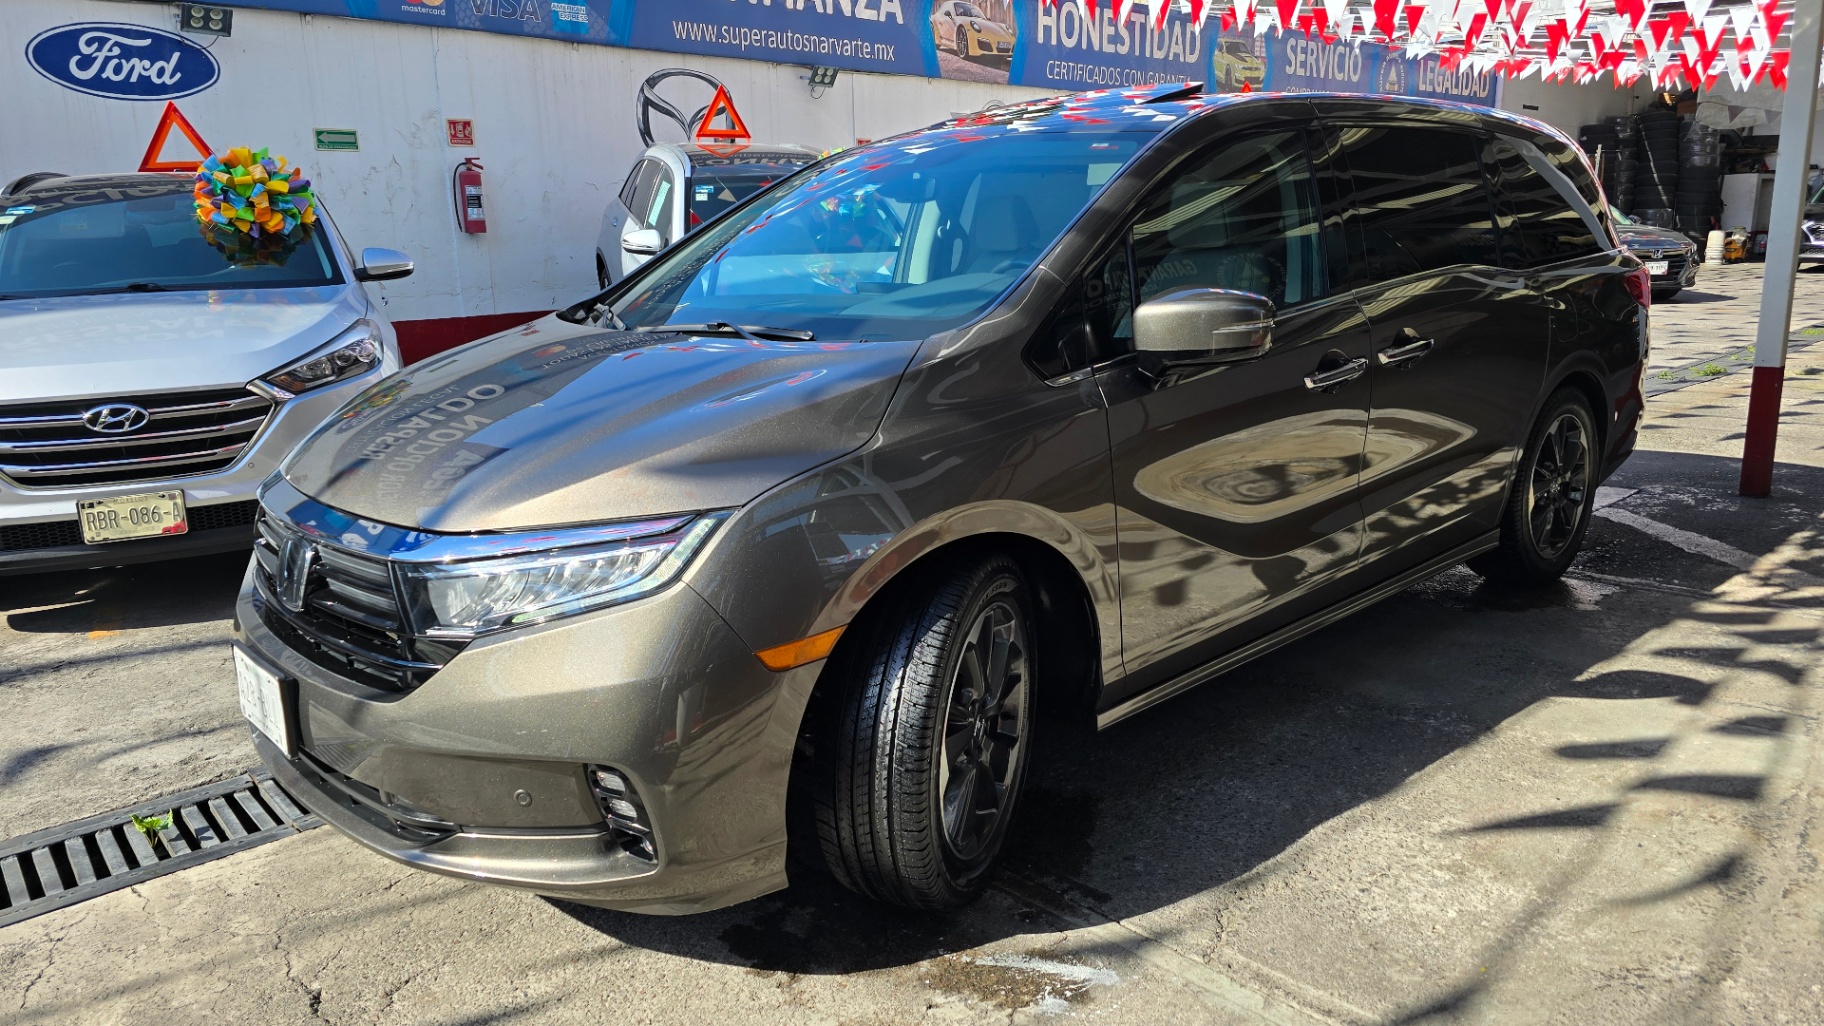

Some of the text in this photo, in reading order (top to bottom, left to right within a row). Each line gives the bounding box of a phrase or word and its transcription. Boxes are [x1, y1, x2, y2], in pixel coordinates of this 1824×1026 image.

[401, 5, 446, 16] mastercard
[470, 0, 541, 22] VISA
[551, 2, 586, 14] AMERICAN
[558, 11, 588, 23] EXPRESS
[672, 20, 896, 62] www.superautosnarvarte.mx
[1037, 0, 1201, 64] HONESTIDAD
[69, 31, 182, 86] Ford
[1285, 37, 1362, 83] SERVICIO
[1046, 60, 1121, 86] CERTIFICADOS
[1123, 69, 1145, 87] CON
[1418, 59, 1490, 98] LEGALIDAD
[86, 502, 182, 531] RBR-086-A
